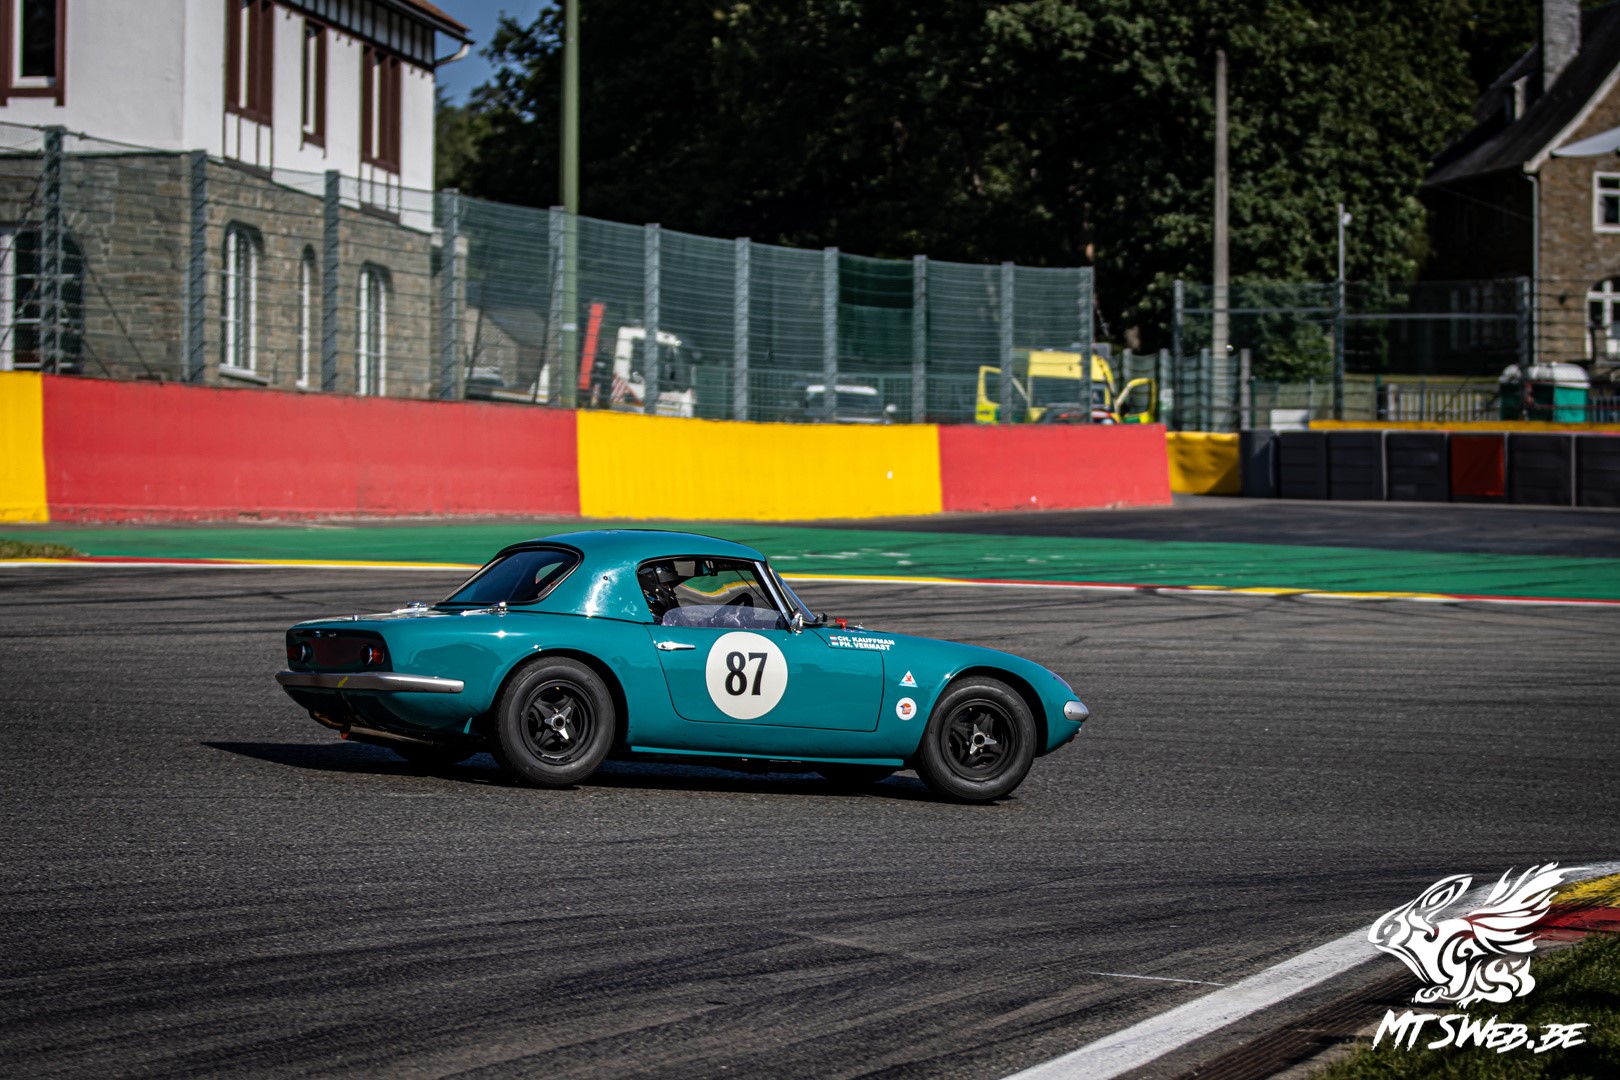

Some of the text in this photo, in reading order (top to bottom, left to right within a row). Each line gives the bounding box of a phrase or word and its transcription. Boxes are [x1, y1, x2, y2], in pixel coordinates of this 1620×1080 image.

[852, 636, 895, 646] KAUFFMAN
[853, 642, 891, 651] VERMAST
[725, 651, 768, 696] 87
